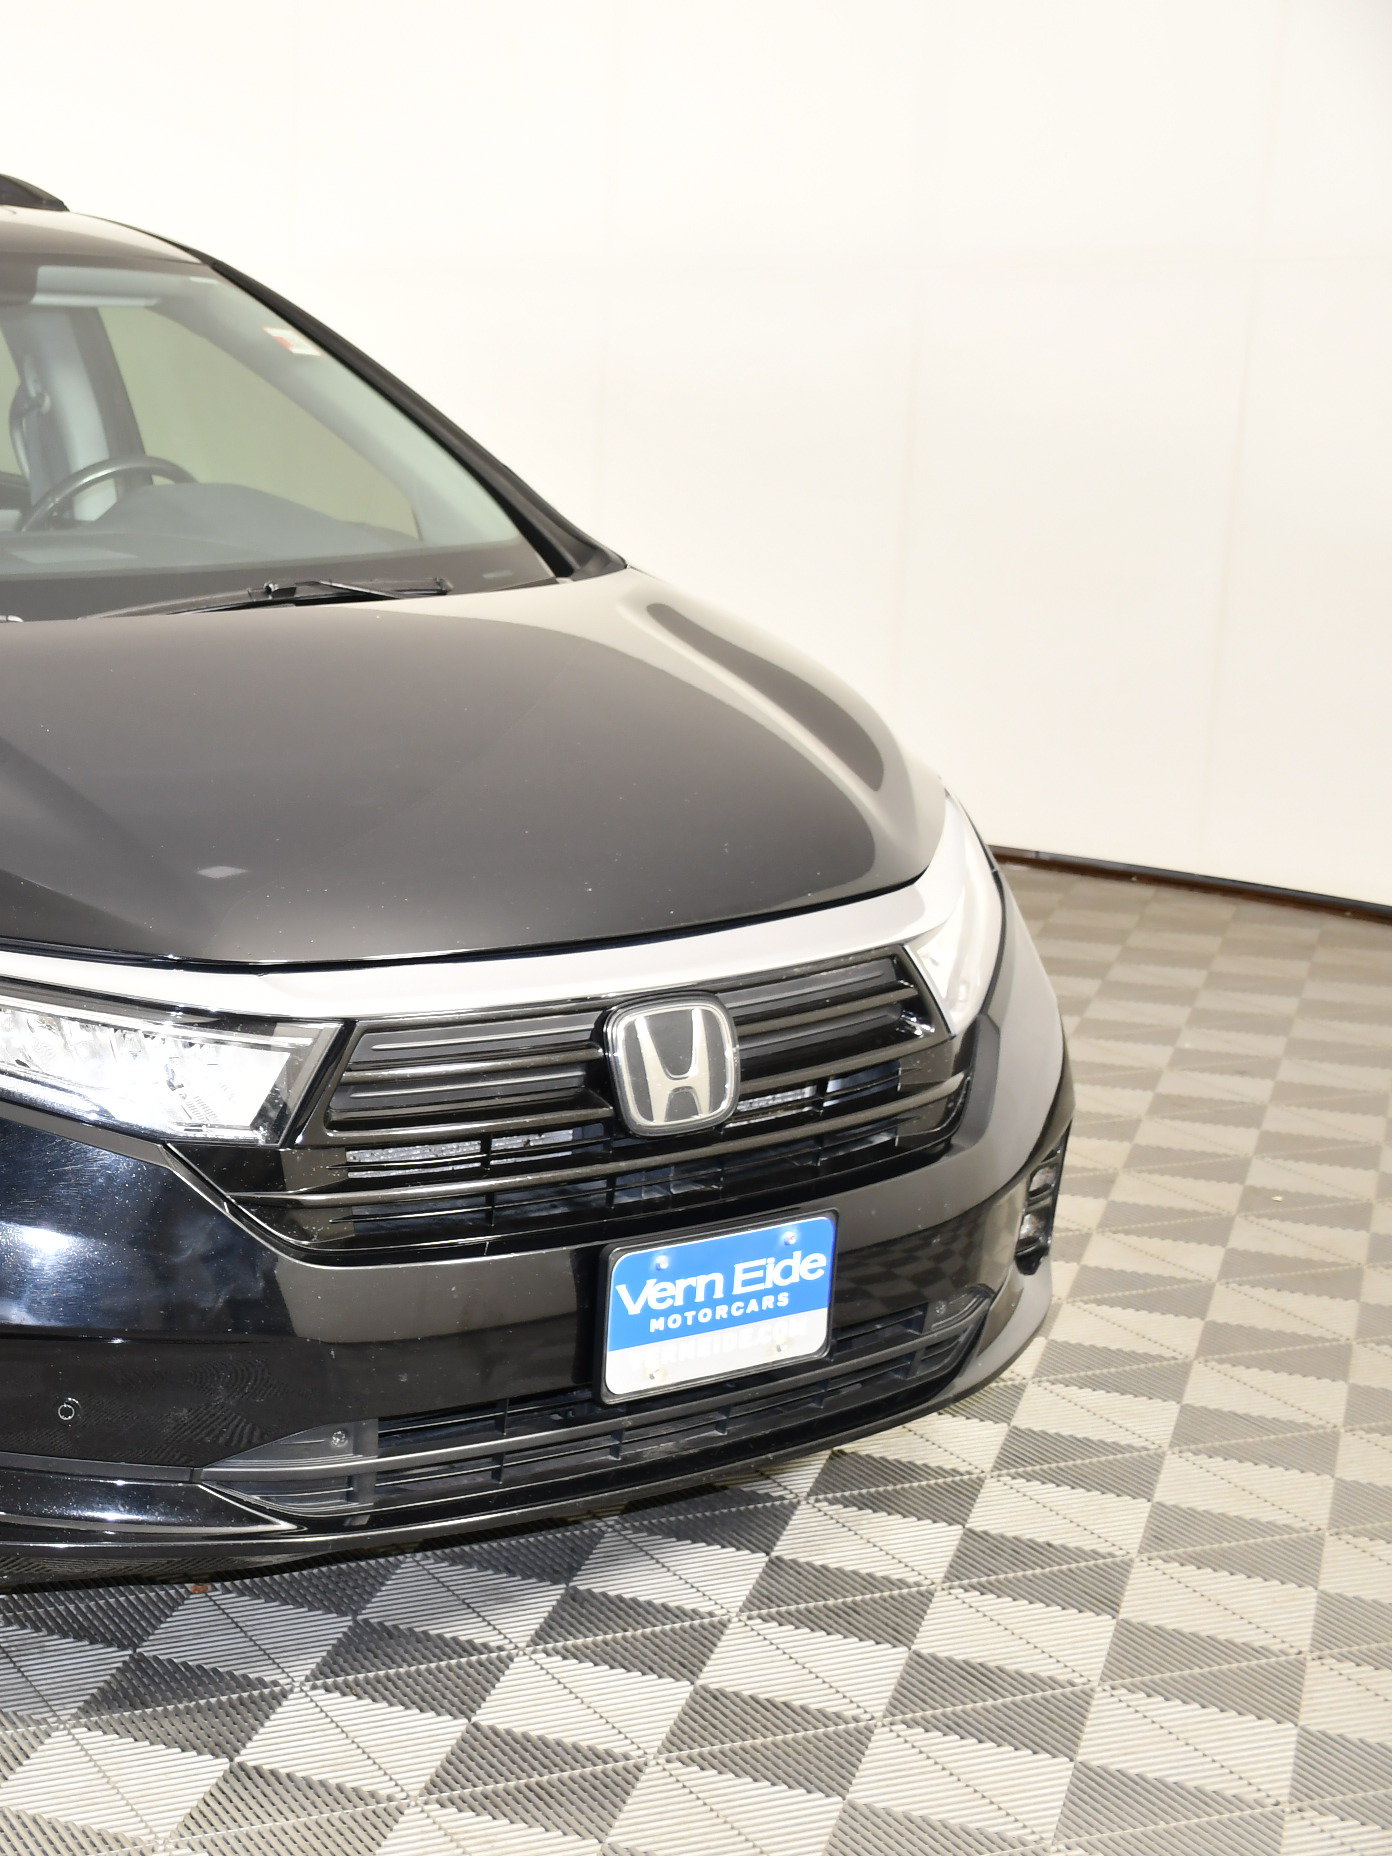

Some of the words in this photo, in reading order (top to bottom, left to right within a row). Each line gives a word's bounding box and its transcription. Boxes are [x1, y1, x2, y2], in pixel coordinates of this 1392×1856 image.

[615, 1272, 724, 1315] Vern
[731, 1250, 827, 1295] Eide
[649, 1291, 790, 1333] MOTORCARS
